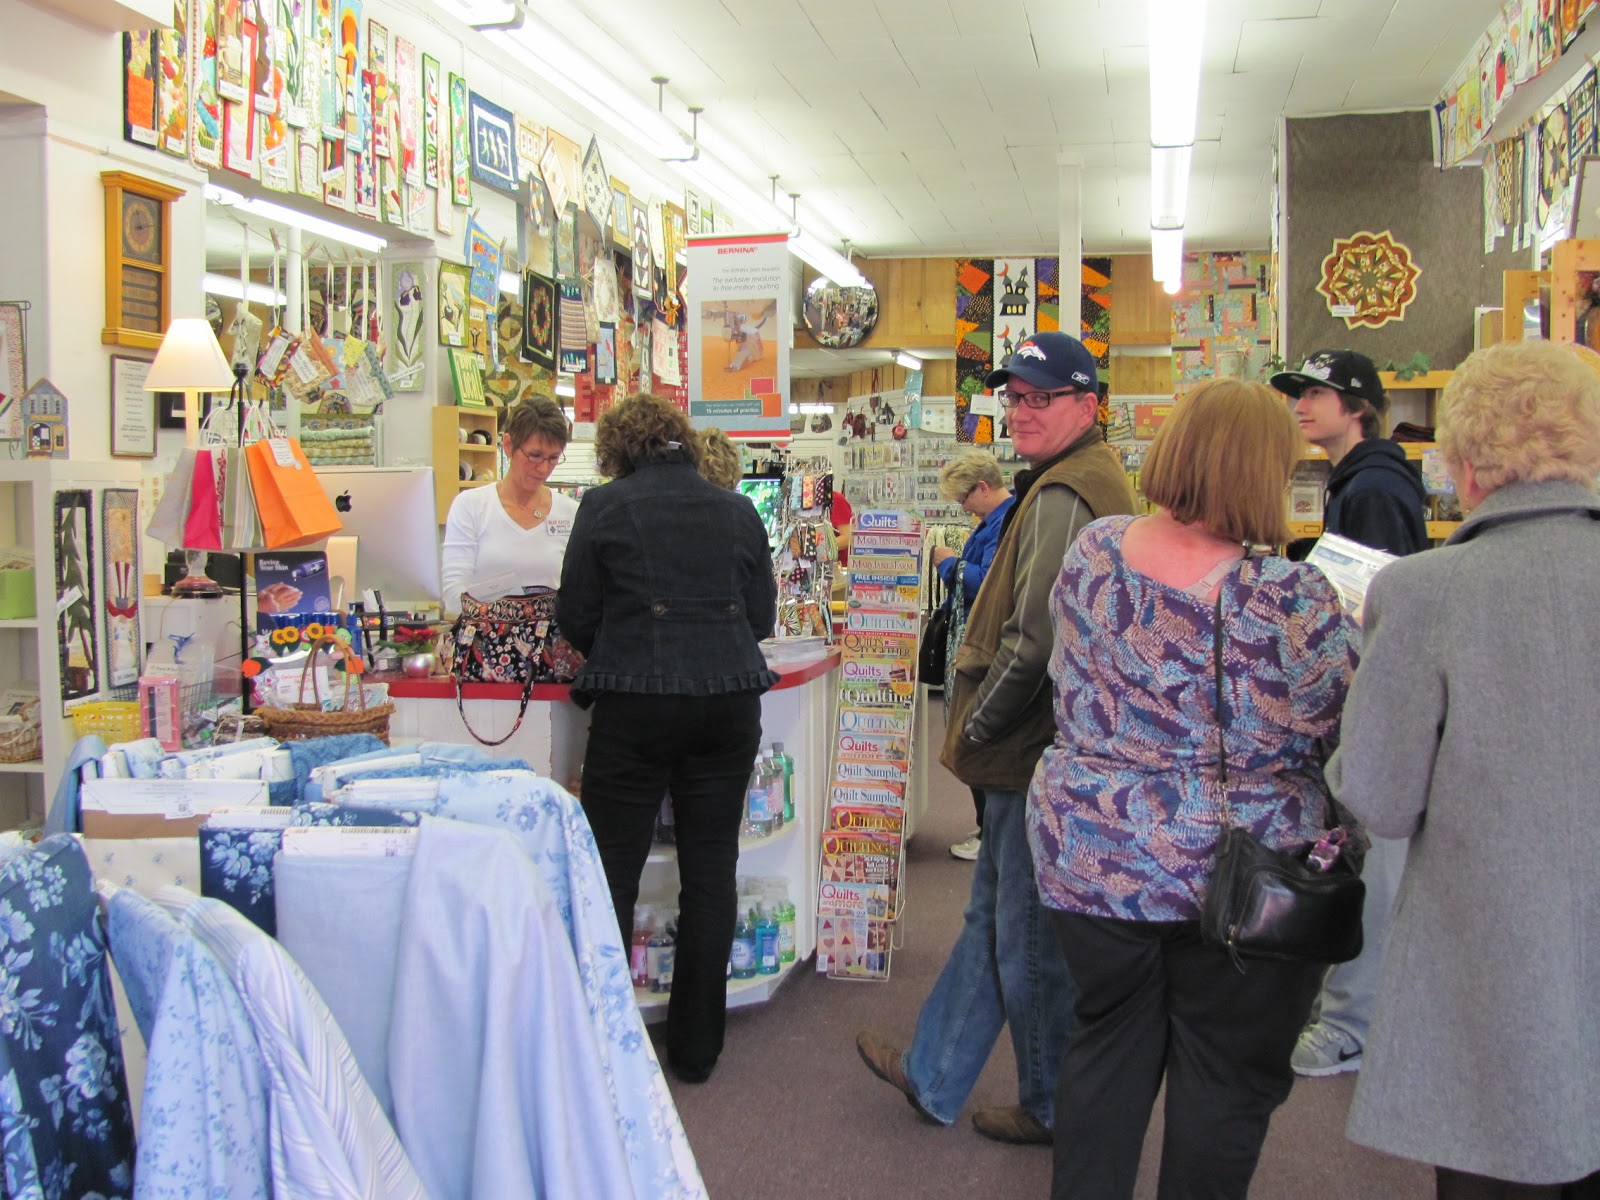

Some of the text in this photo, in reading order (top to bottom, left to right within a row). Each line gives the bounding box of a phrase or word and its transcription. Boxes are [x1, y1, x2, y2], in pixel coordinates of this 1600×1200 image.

[717, 247, 755, 255] BERNINA
[751, 275, 781, 283] revolution
[720, 284, 755, 292] free-motion
[860, 513, 898, 528] Quilts
[854, 573, 871, 581] FREE
[849, 612, 912, 630] QUILTING
[844, 661, 882, 676] Quilts
[841, 710, 905, 732] QUILTING
[840, 735, 878, 752] Quilts
[837, 763, 902, 779] Quilt Sampler
[833, 787, 899, 803] Quilt Sampler
[836, 810, 901, 832] QUILTING
[823, 836, 889, 859] QUILTING
[821, 883, 860, 901] Quilts
[834, 900, 865, 909] more
